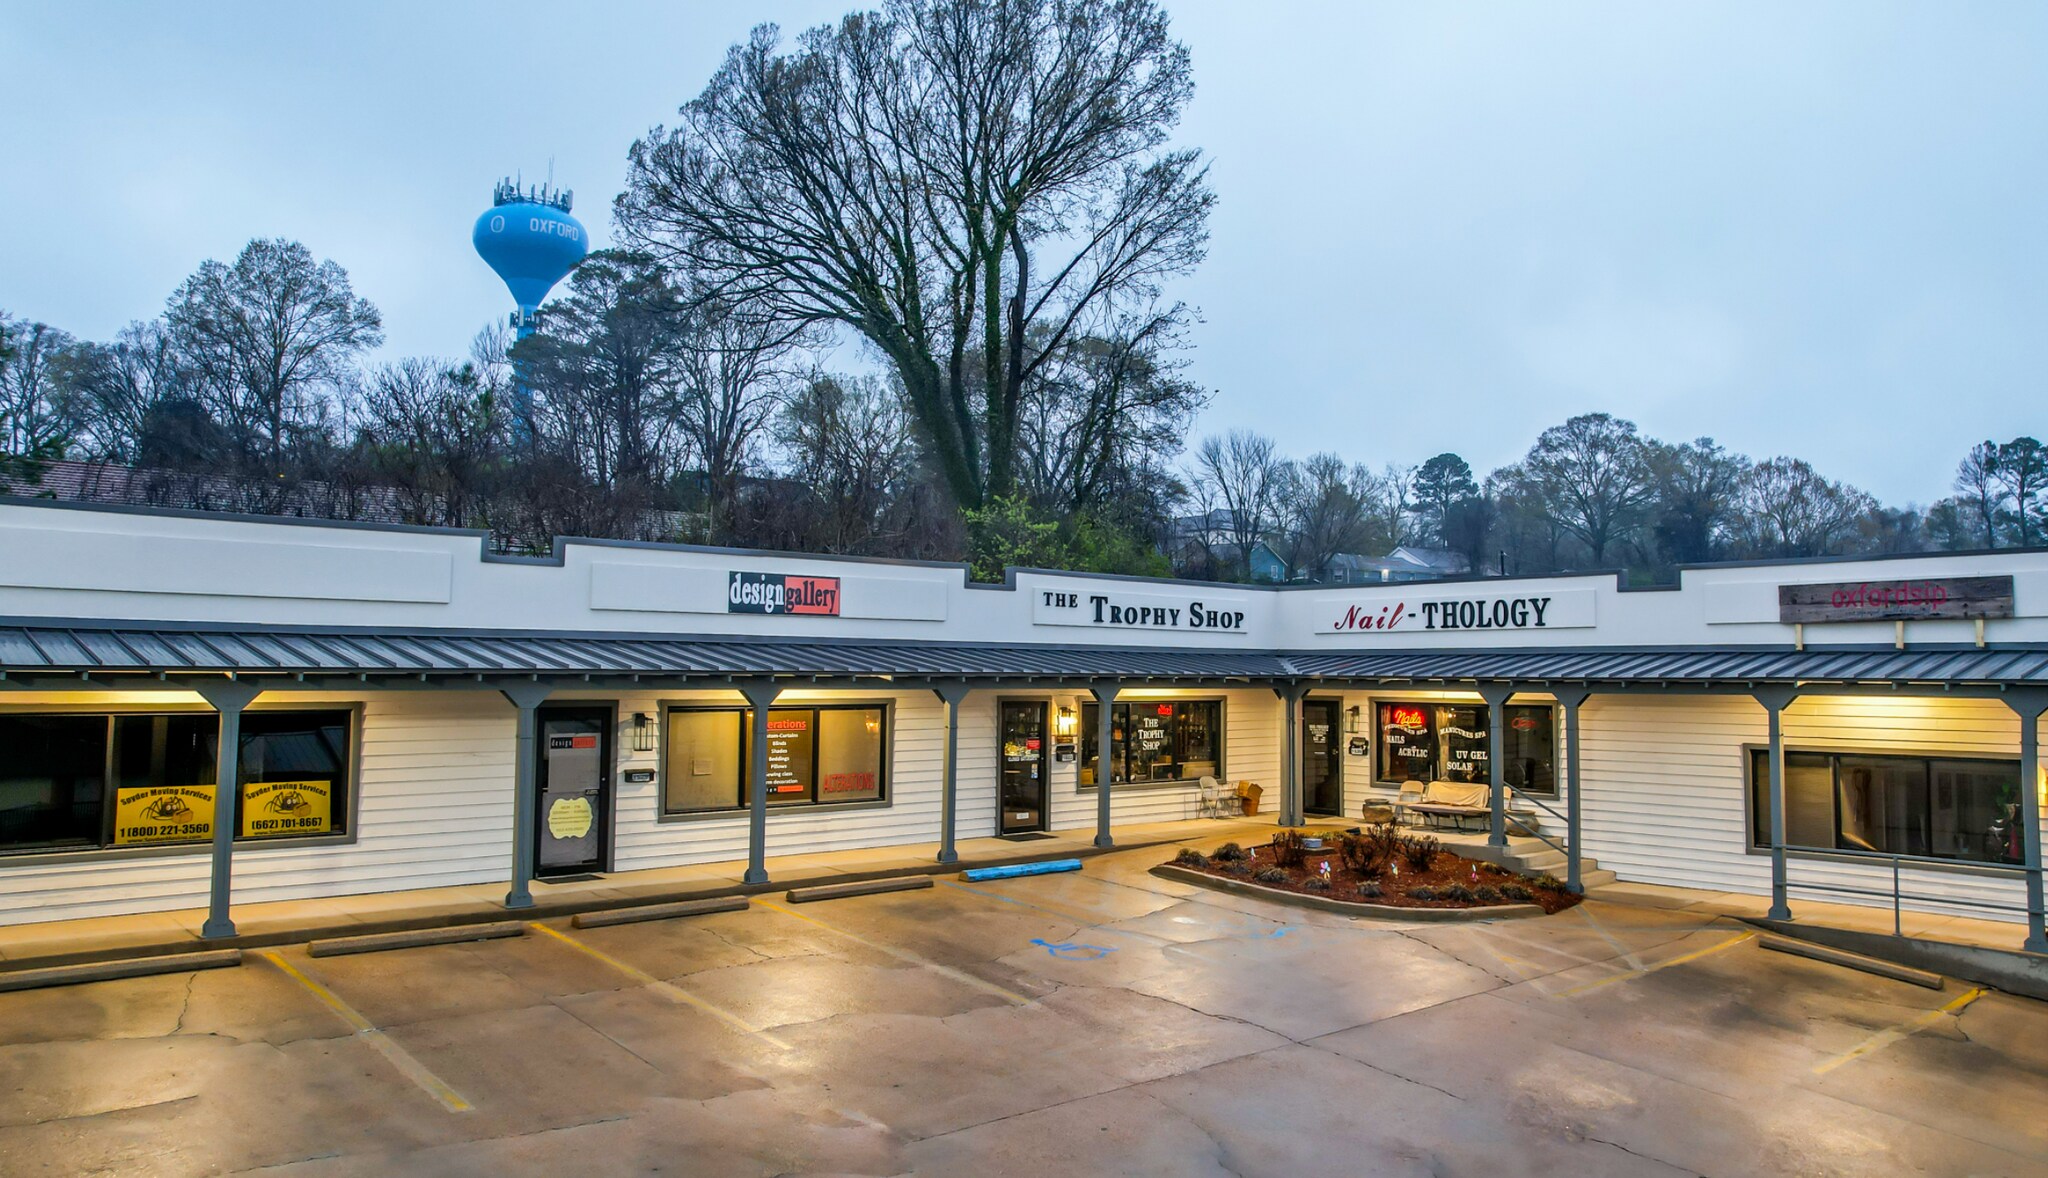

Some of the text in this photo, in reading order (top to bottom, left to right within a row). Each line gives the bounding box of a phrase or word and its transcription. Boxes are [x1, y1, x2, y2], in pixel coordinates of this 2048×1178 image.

[529, 217, 579, 241] OXFORD
[1831, 581, 1947, 610] oxfordsip
[1043, 592, 1244, 629] THE TROPHY SHOP
[1143, 717, 1159, 728] THE
[1395, 710, 1422, 724] Nails
[767, 719, 806, 729] erations
[1138, 729, 1164, 740] TROPHY
[1439, 727, 1487, 739] MANICURES SPA
[1142, 740, 1160, 751] SHOP
[1386, 735, 1405, 744] NAILS
[1398, 747, 1428, 758] ACRYLIC
[1455, 750, 1488, 760] UV GEL
[1446, 761, 1473, 771] SOLAR
[823, 772, 875, 793] ALTERATIONS
[120, 787, 212, 806] Spyder Moving Services
[245, 783, 327, 800] Spyder Moving Services
[251, 817, 322, 830] (662) 701-8667
[120, 823, 209, 837] 1 (800) 221-3560
